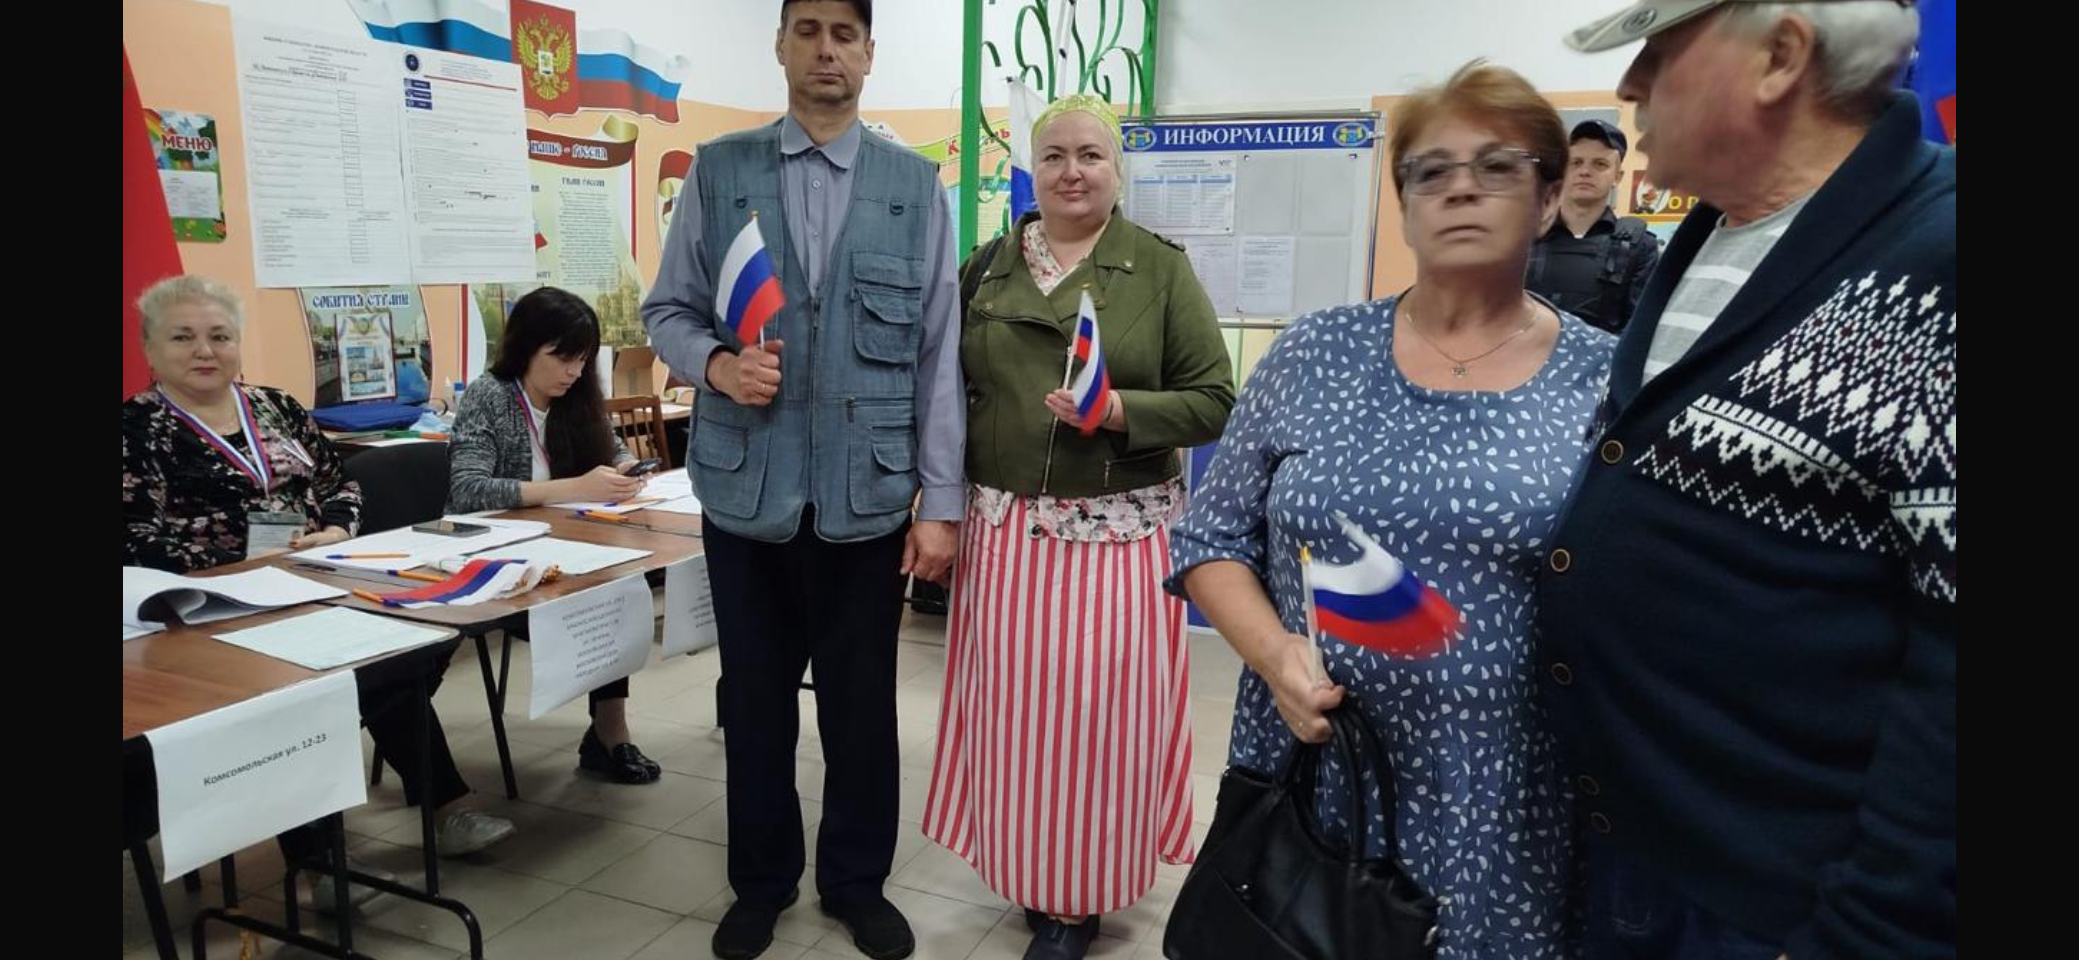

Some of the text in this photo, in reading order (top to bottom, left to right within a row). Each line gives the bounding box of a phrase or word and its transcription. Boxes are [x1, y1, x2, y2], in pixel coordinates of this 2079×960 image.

[161, 134, 213, 150] МЕНЮ
[1164, 126, 1326, 145] ИНФОРМАЦИЯ
[203, 751, 283, 786] Комсомольская
